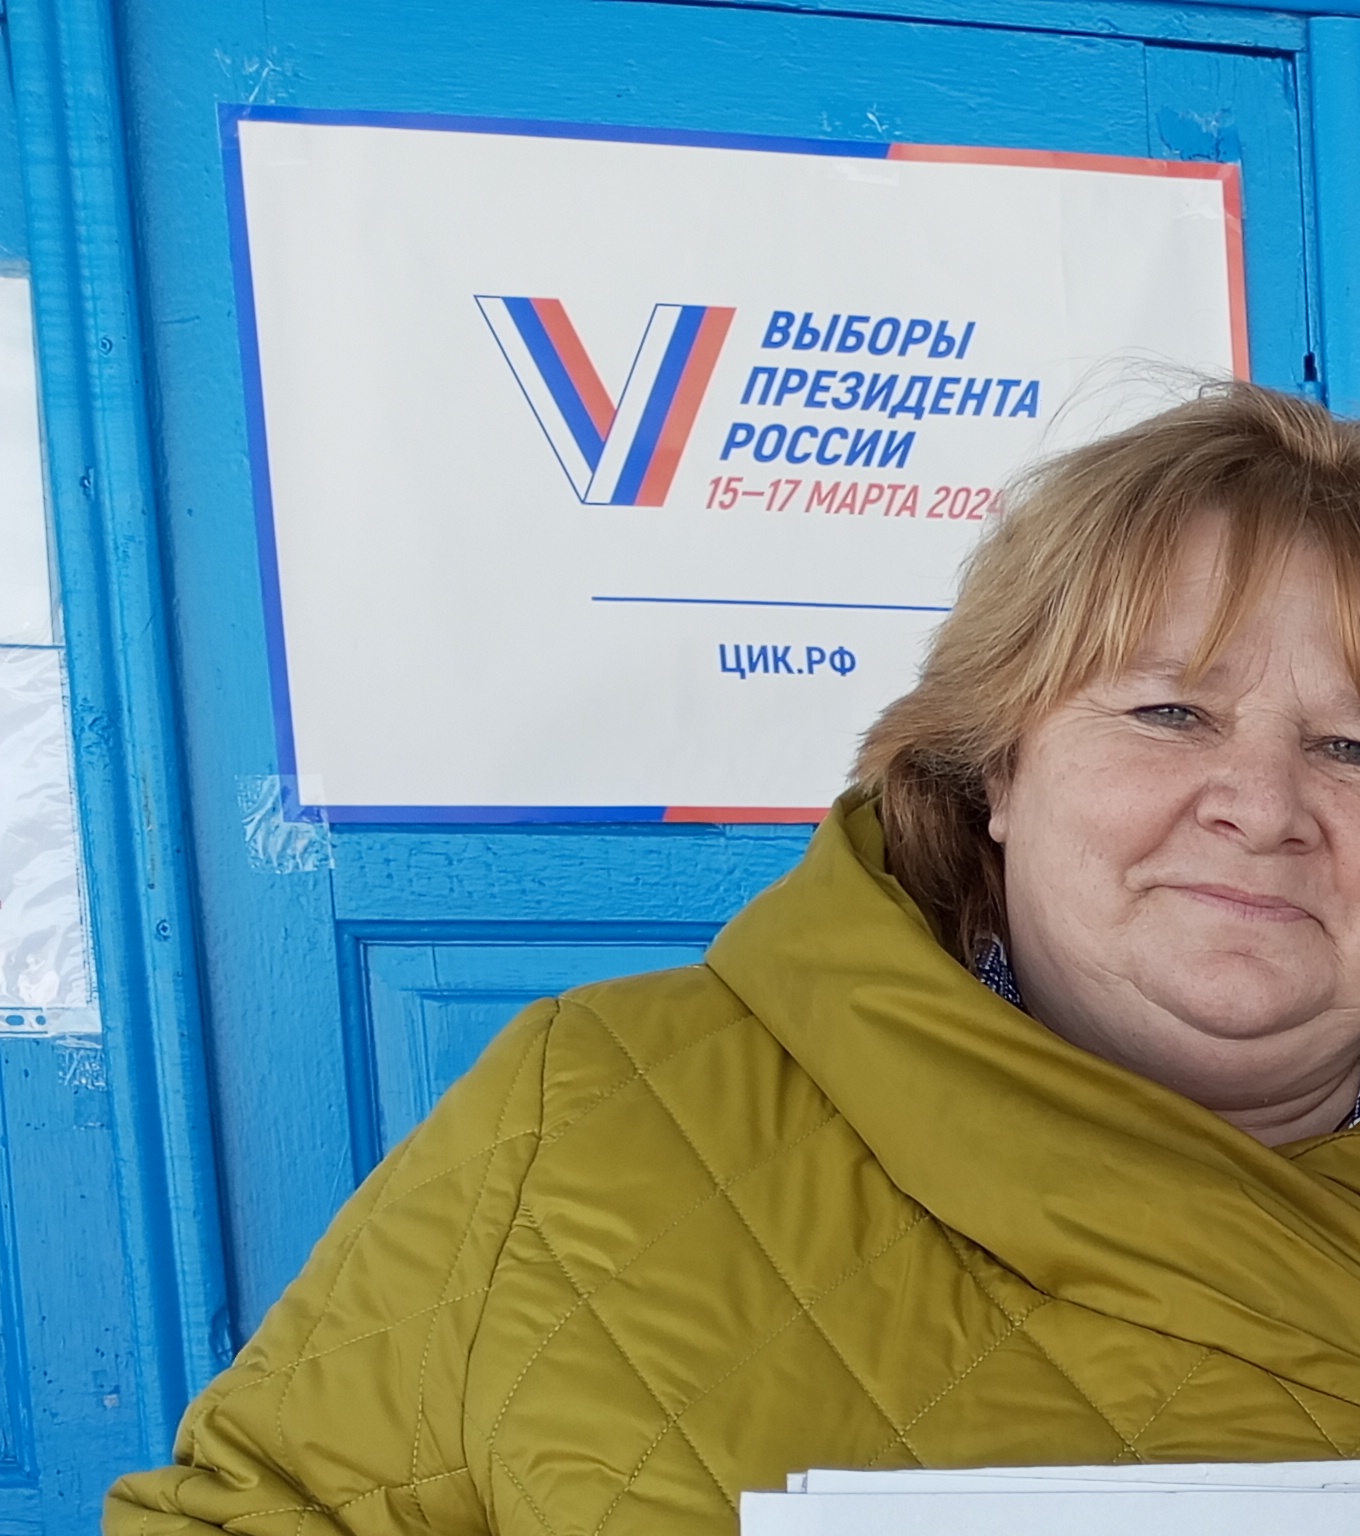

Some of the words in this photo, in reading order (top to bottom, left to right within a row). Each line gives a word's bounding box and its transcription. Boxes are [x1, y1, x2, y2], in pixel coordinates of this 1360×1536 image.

[760, 310, 976, 360] ВЫБОРЫ
[740, 366, 1042, 421] ПРЕЗИДЕНТА
[719, 421, 916, 470] РОССИИ
[805, 479, 920, 518] МАРТА
[718, 643, 857, 680] ЦИК.РФ
